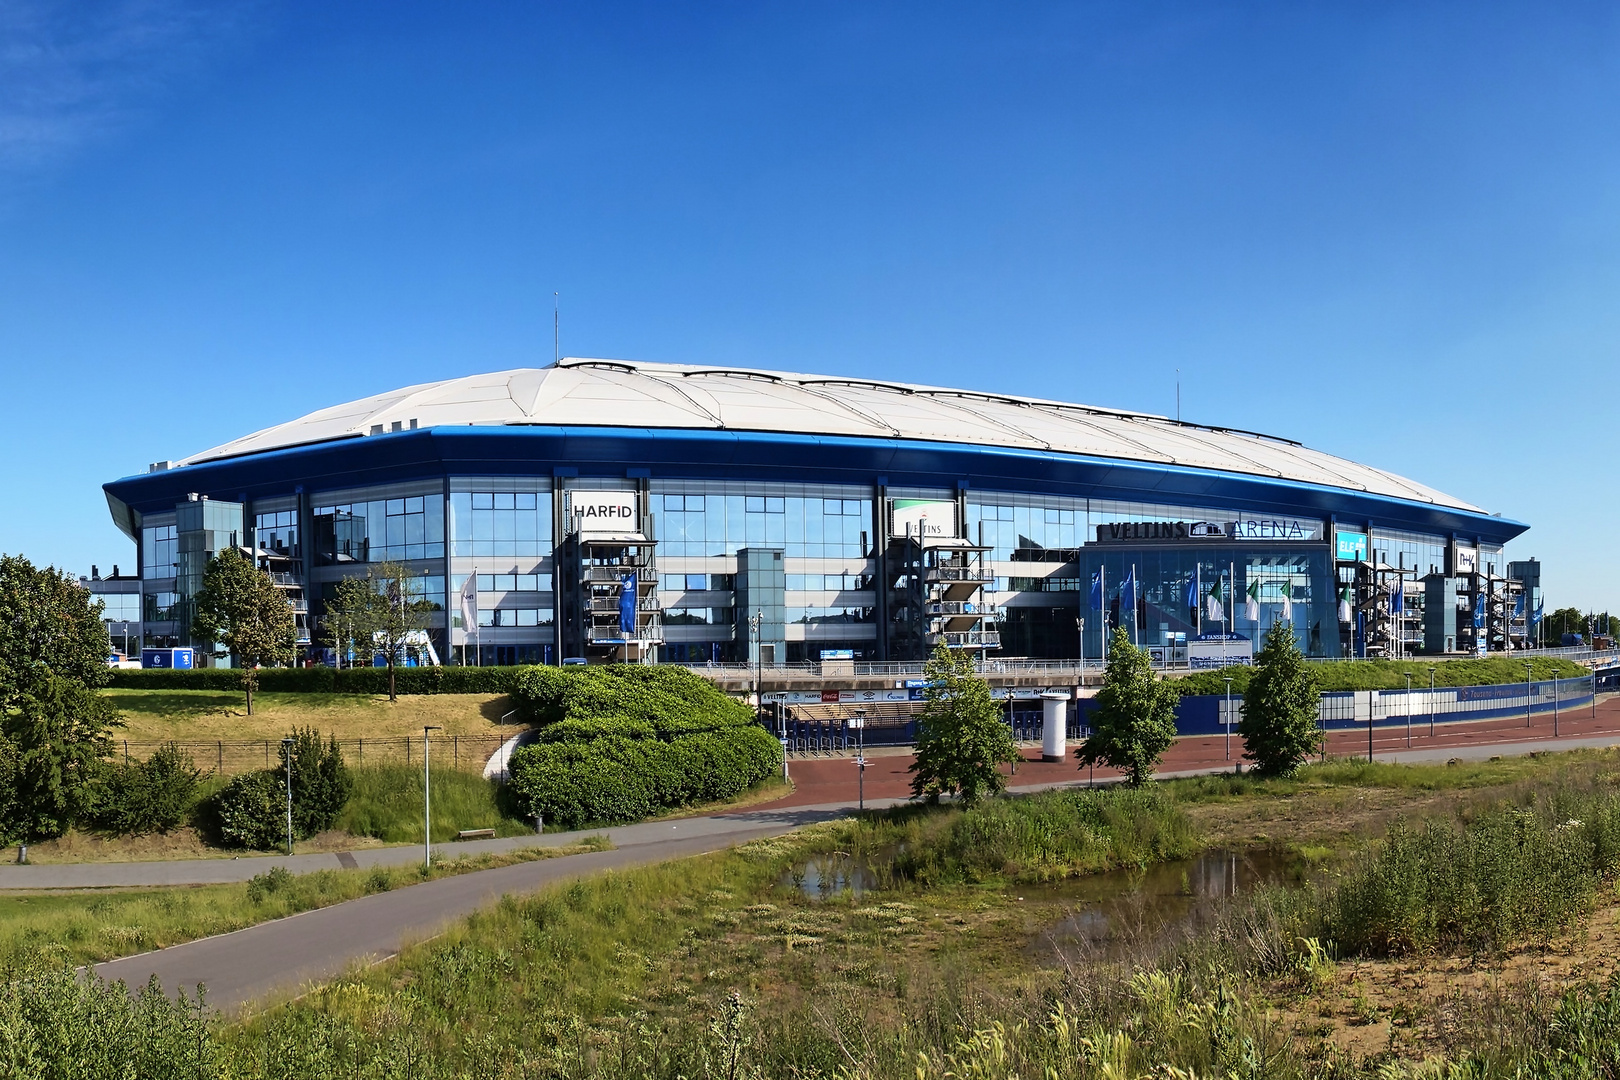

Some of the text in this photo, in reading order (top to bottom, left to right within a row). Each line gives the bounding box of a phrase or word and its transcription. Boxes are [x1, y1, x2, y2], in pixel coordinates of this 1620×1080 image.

[908, 524, 942, 534] VETINS
[1109, 520, 1303, 539] VELTINS ARENA
[1340, 541, 1355, 553] ELE
